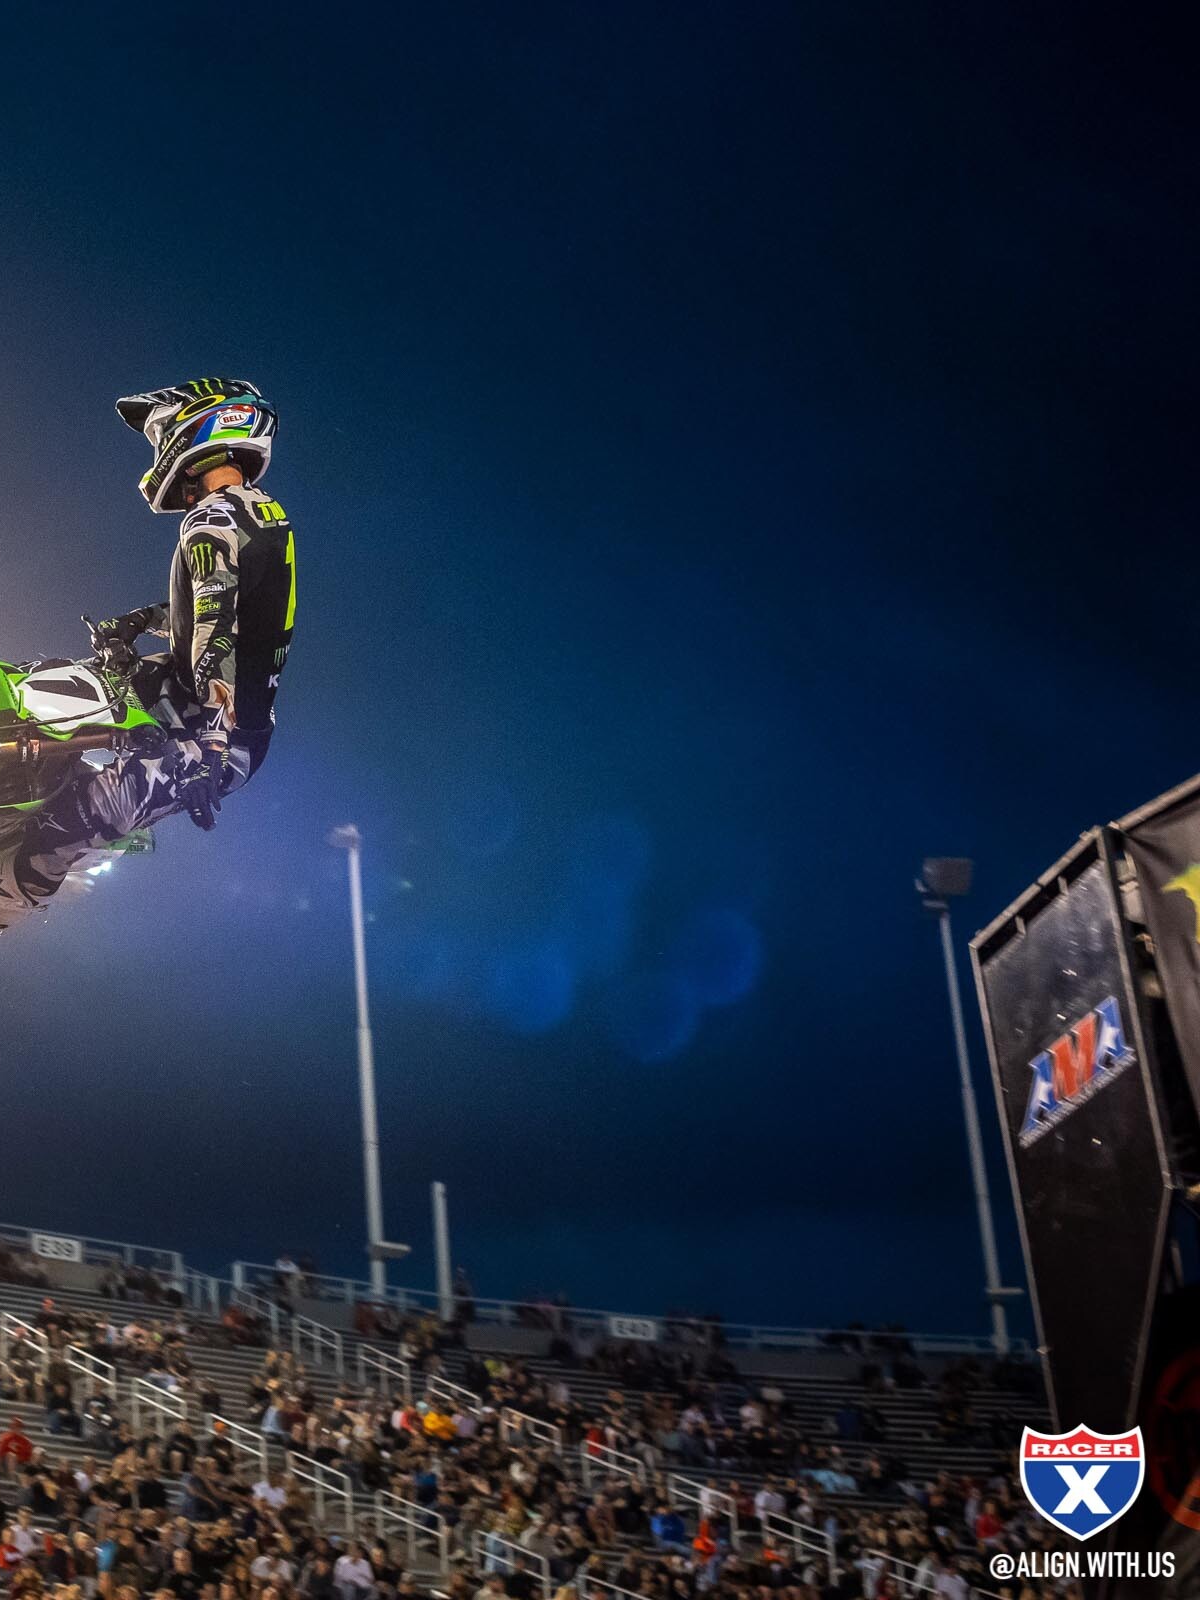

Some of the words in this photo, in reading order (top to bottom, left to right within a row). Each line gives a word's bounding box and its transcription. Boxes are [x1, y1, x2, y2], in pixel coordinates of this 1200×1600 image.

[222, 414, 245, 424] BELL
[157, 435, 189, 473] MONSTER
[195, 651, 216, 697] NSTER
